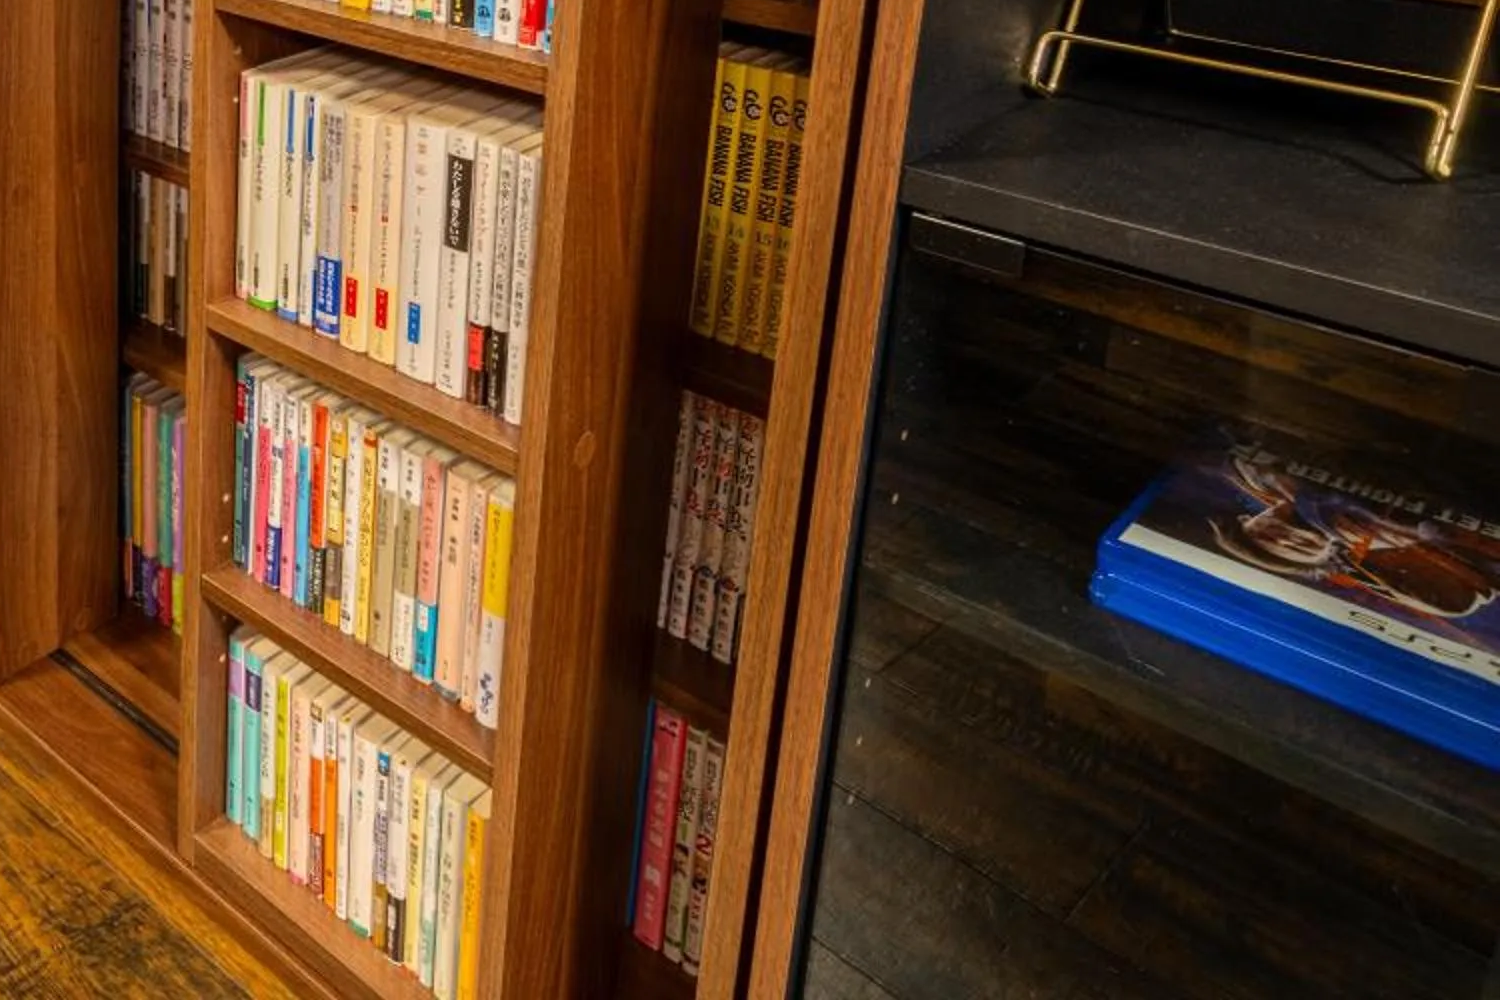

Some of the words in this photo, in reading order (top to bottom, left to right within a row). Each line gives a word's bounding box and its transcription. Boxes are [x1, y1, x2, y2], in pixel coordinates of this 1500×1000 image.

[712, 125, 732, 177] BANANA
[735, 132, 757, 184] BANANA
[760, 138, 784, 192] BANANA
[449, 160, 463, 246] わたしを離さないで
[708, 179, 726, 207] FISH
[731, 185, 750, 215] FISH
[756, 193, 776, 224] FISH
[778, 198, 797, 229] FISH
[1285, 458, 1427, 515] FIGHTER
[1347, 610, 1473, 661] PS5
